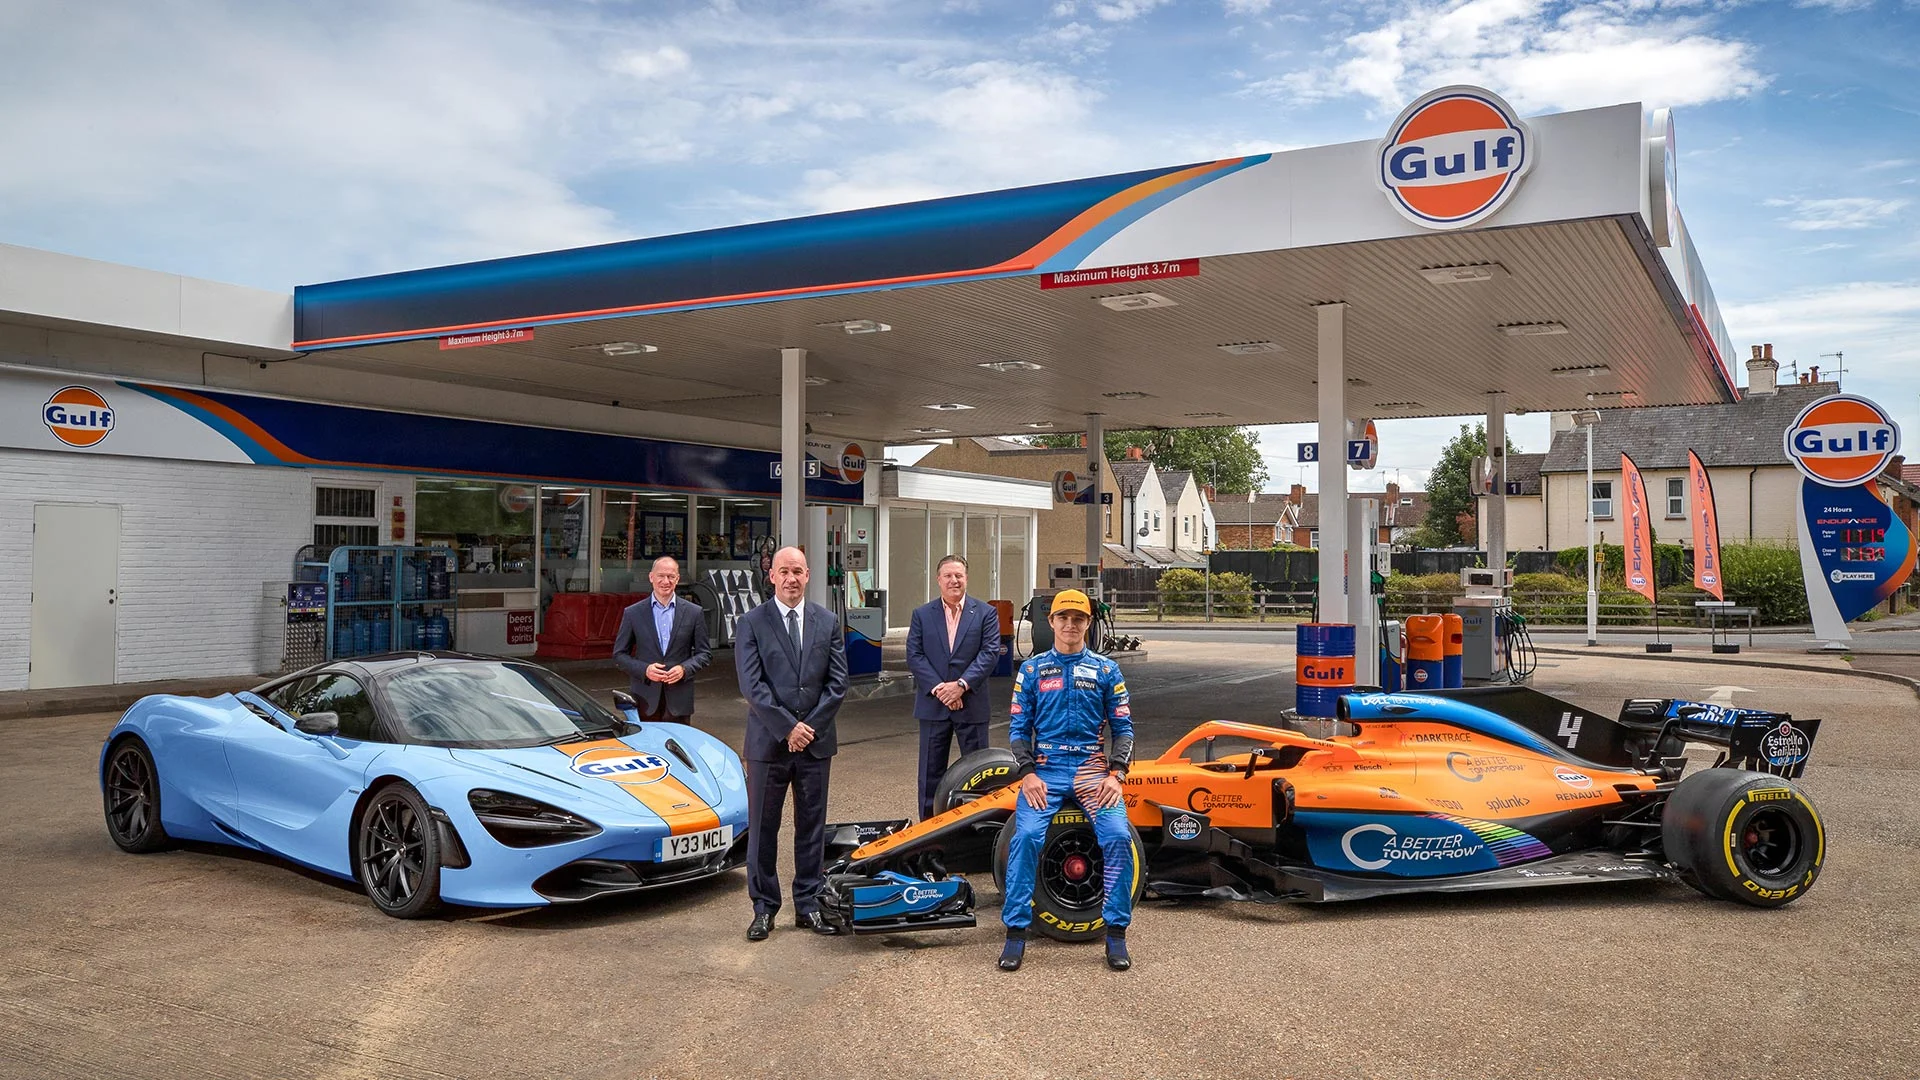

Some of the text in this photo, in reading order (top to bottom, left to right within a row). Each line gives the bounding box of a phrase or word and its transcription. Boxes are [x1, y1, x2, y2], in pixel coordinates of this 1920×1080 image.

[1389, 136, 1515, 181] Gulf
[1053, 262, 1180, 284] Maximum Height 3.7m
[447, 329, 524, 346] Maximum Height 3.7m
[45, 405, 111, 428] Gulf
[1794, 429, 1890, 453] Gulf
[1303, 444, 1314, 461] 8
[1354, 442, 1364, 458] 7
[808, 462, 816, 475] 5
[843, 456, 865, 469] Gulf
[1103, 494, 1110, 503] 3
[509, 614, 532, 624] beers
[1463, 616, 1483, 625] Gulf
[514, 624, 533, 632] wines
[511, 633, 532, 643] spirits
[1303, 666, 1344, 680] Gulf
[1558, 712, 1583, 748] 4
[1416, 733, 1472, 743] DARKTRACE
[1767, 735, 1803, 747] Estrella
[1769, 746, 1801, 758] Galicia
[579, 756, 662, 774] Gulf
[1147, 776, 1179, 785] MILLE
[1556, 790, 1603, 801] RENAULT
[1748, 788, 1790, 802] PIRELLI
[671, 830, 726, 856] Y33 MCL
[1384, 834, 1463, 849] A BETTER
